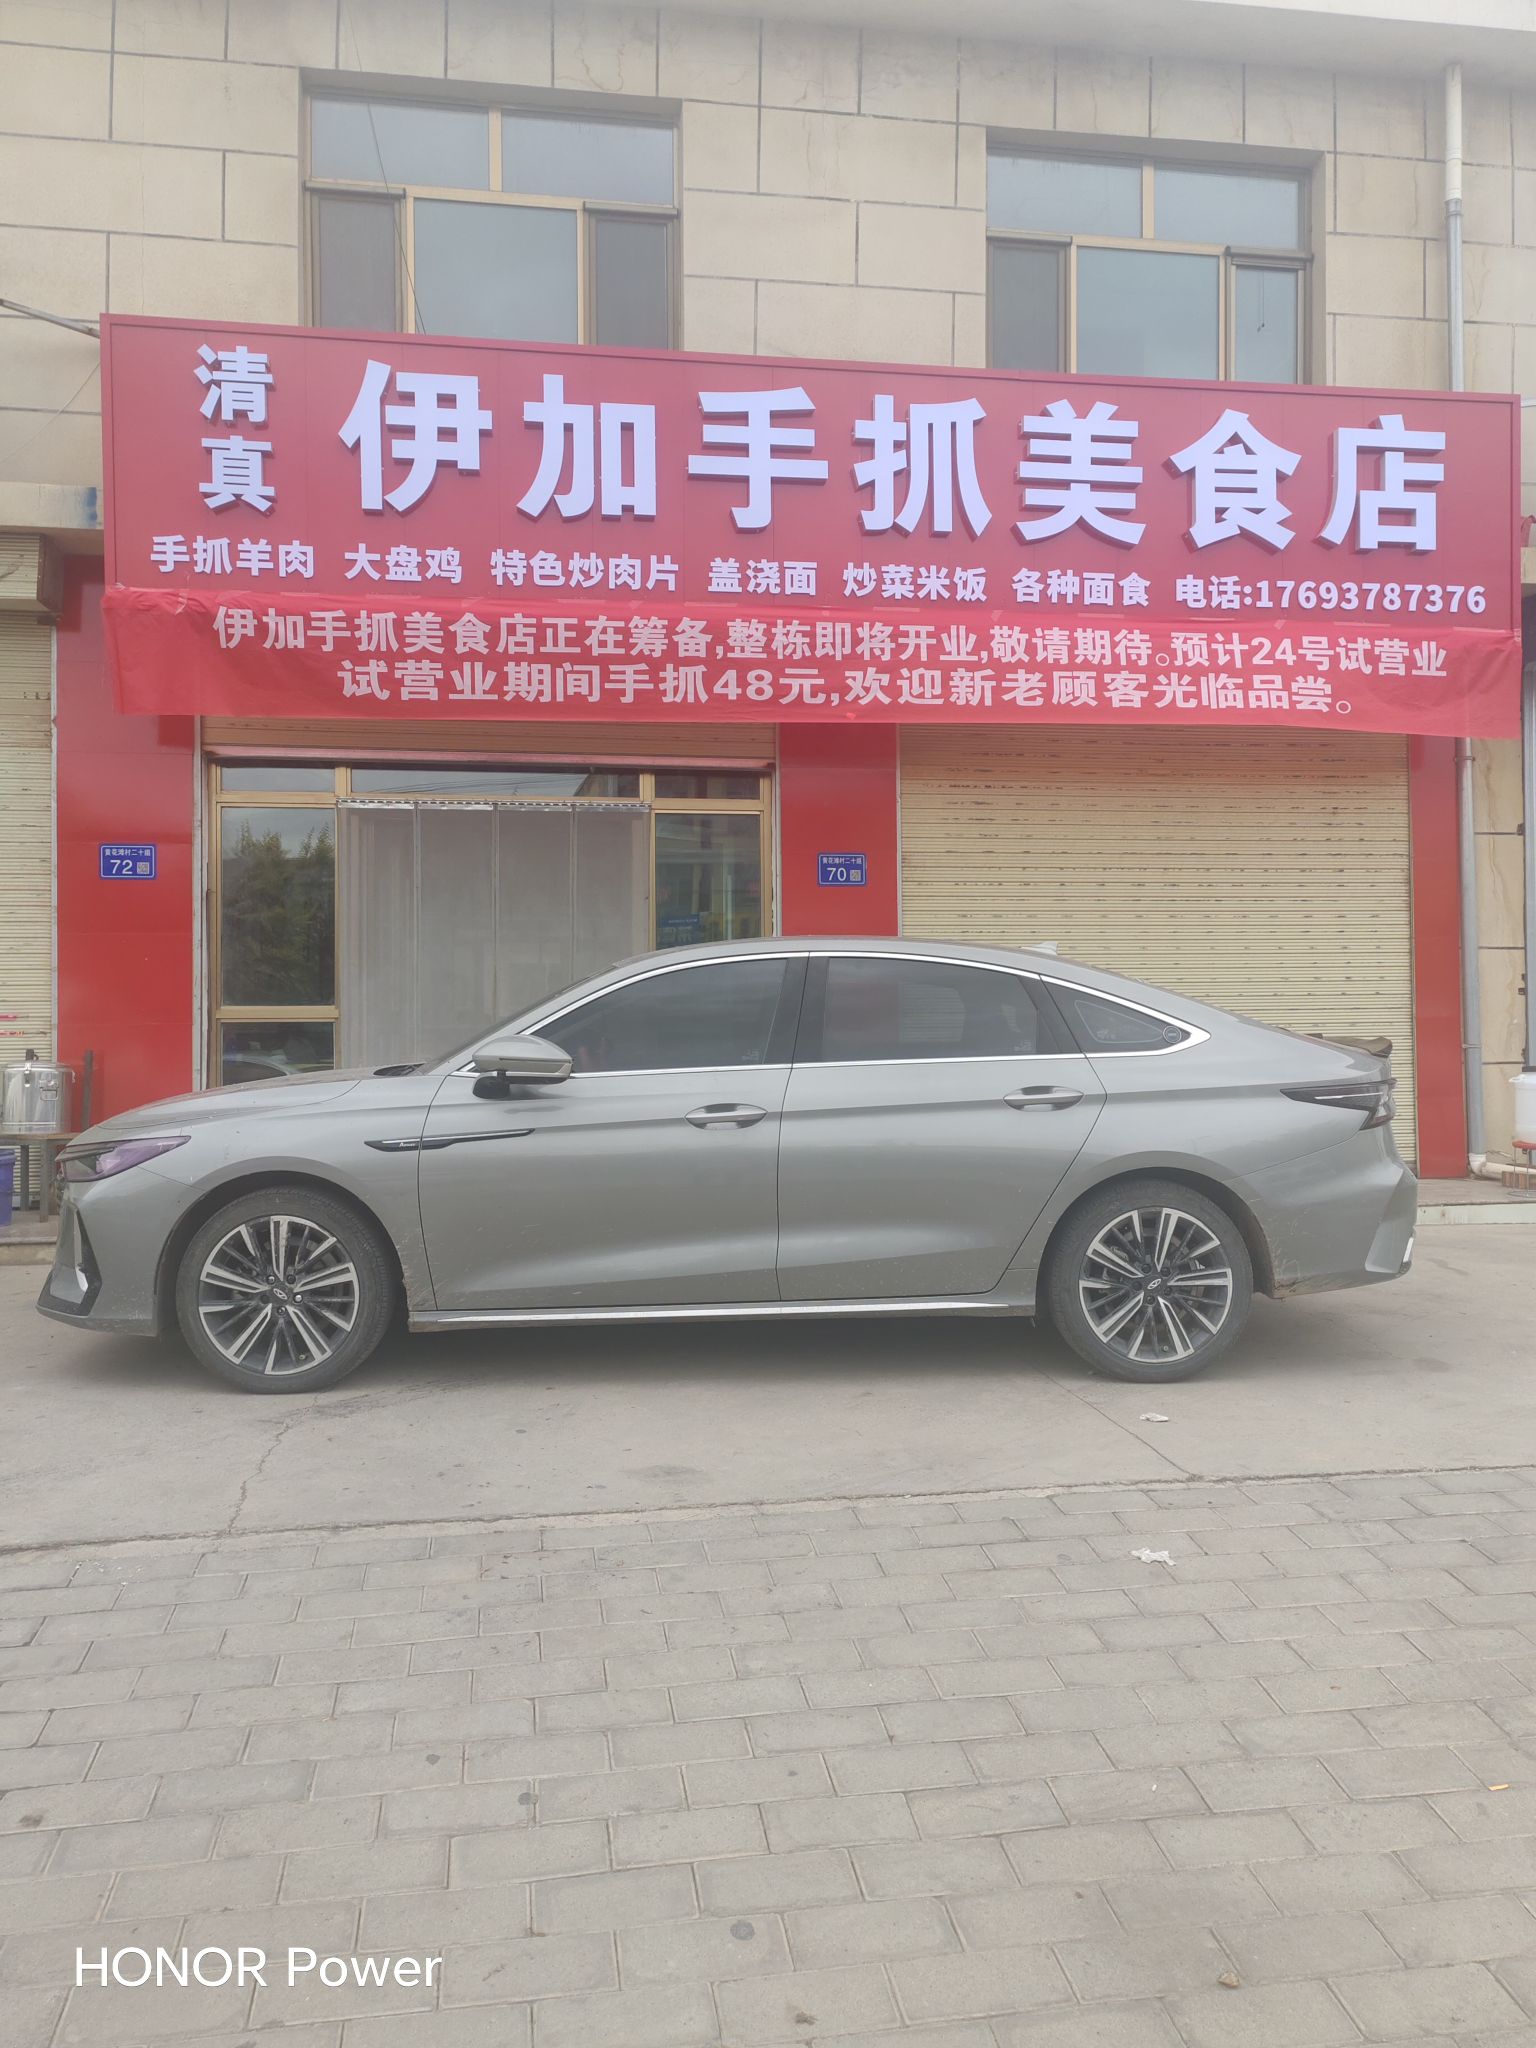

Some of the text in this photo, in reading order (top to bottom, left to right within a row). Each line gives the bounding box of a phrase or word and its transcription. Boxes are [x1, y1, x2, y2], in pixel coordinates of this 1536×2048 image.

[194, 343, 275, 513] 清真
[338, 358, 1448, 552] 伊加手抓美食店
[150, 534, 315, 579] 手抓羊肉
[344, 543, 463, 584] 大盘鸡
[490, 548, 680, 592] 特色炒肉片
[707, 556, 818, 596] 盖浇面
[842, 562, 988, 602] 炒菜米饭
[1011, 567, 1152, 607] 各种面食
[110, 859, 133, 874] 72
[826, 867, 847, 881] 70
